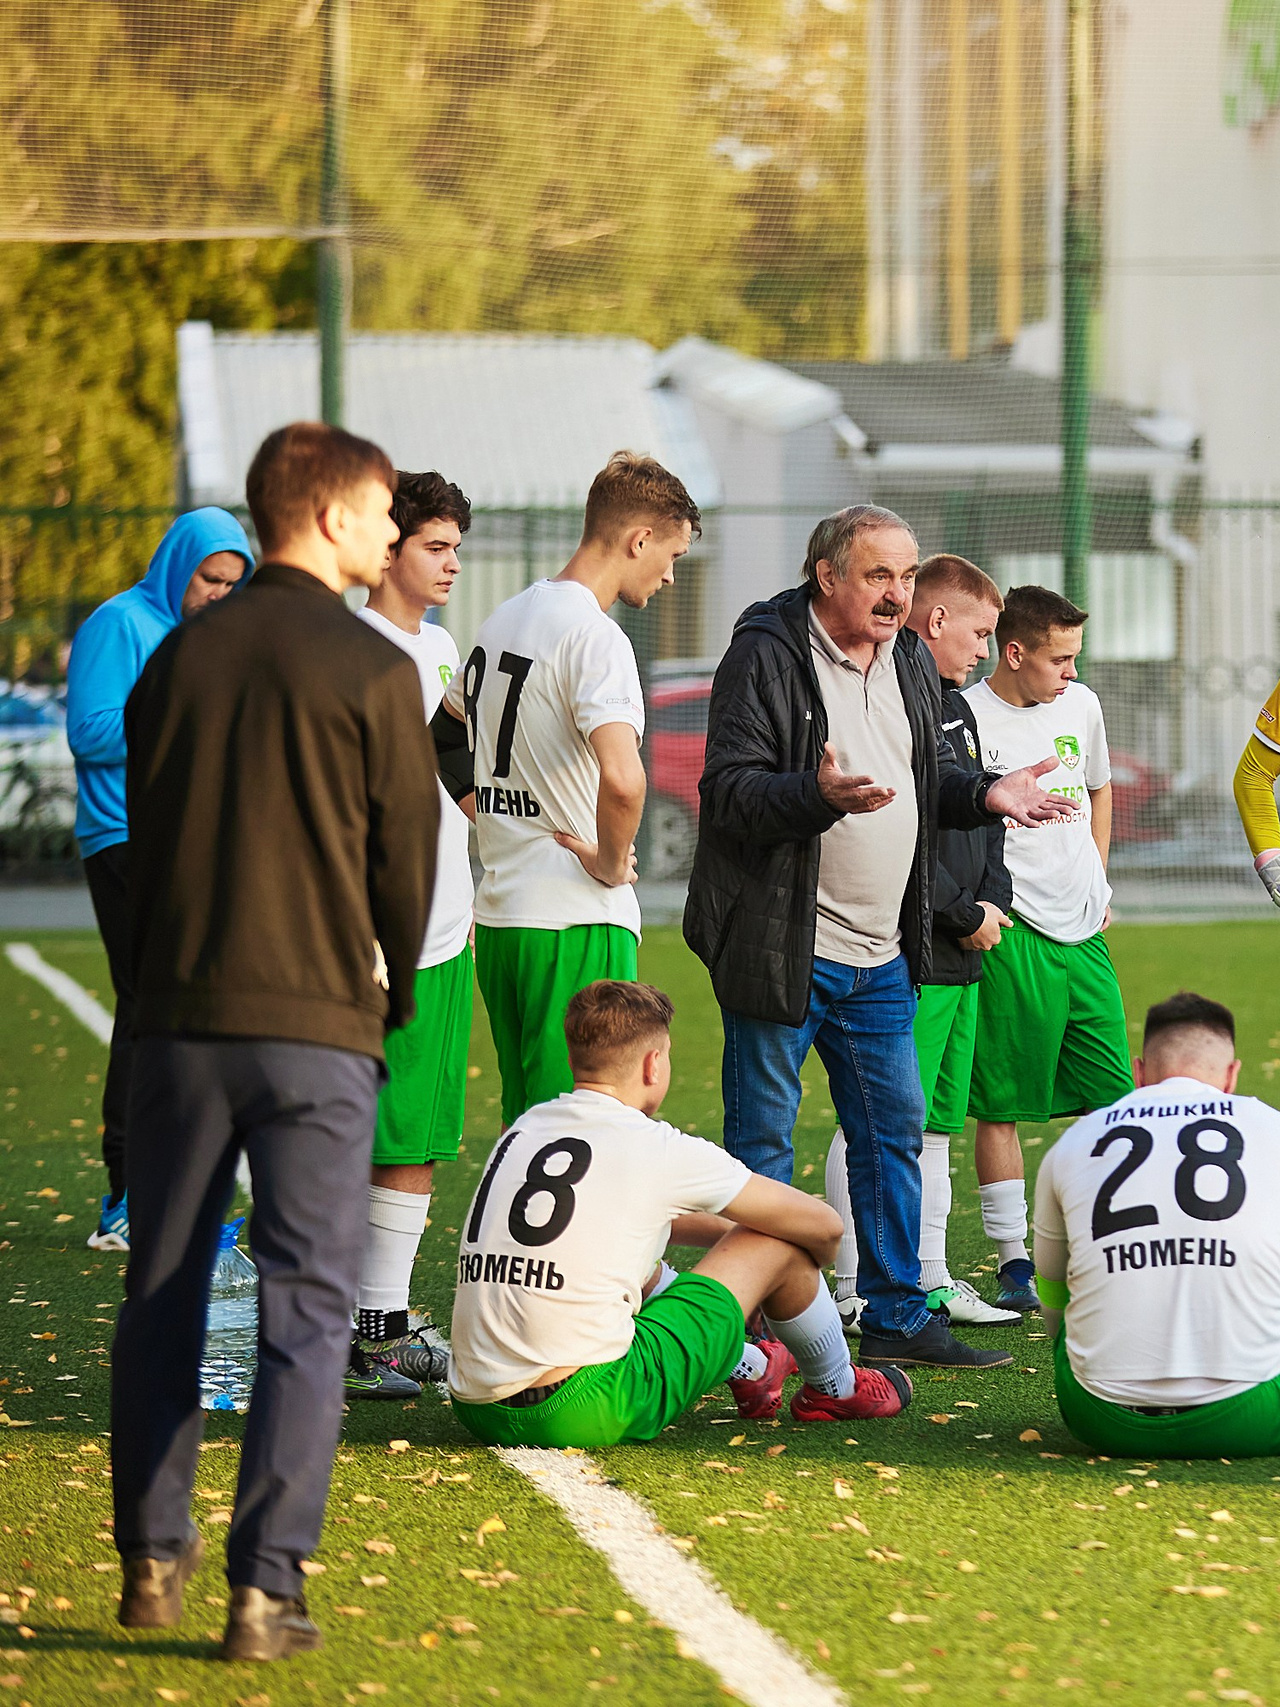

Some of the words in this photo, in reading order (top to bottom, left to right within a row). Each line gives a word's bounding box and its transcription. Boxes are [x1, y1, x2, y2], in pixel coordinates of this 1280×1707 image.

[1105, 1100, 1235, 1126] ПЛИШКИН
[467, 1131, 593, 1247] 18
[1090, 1118, 1247, 1241] 28
[460, 1253, 565, 1291] ТЮМЕНЬ
[1103, 1237, 1237, 1274] ТЮМЕНЬ
